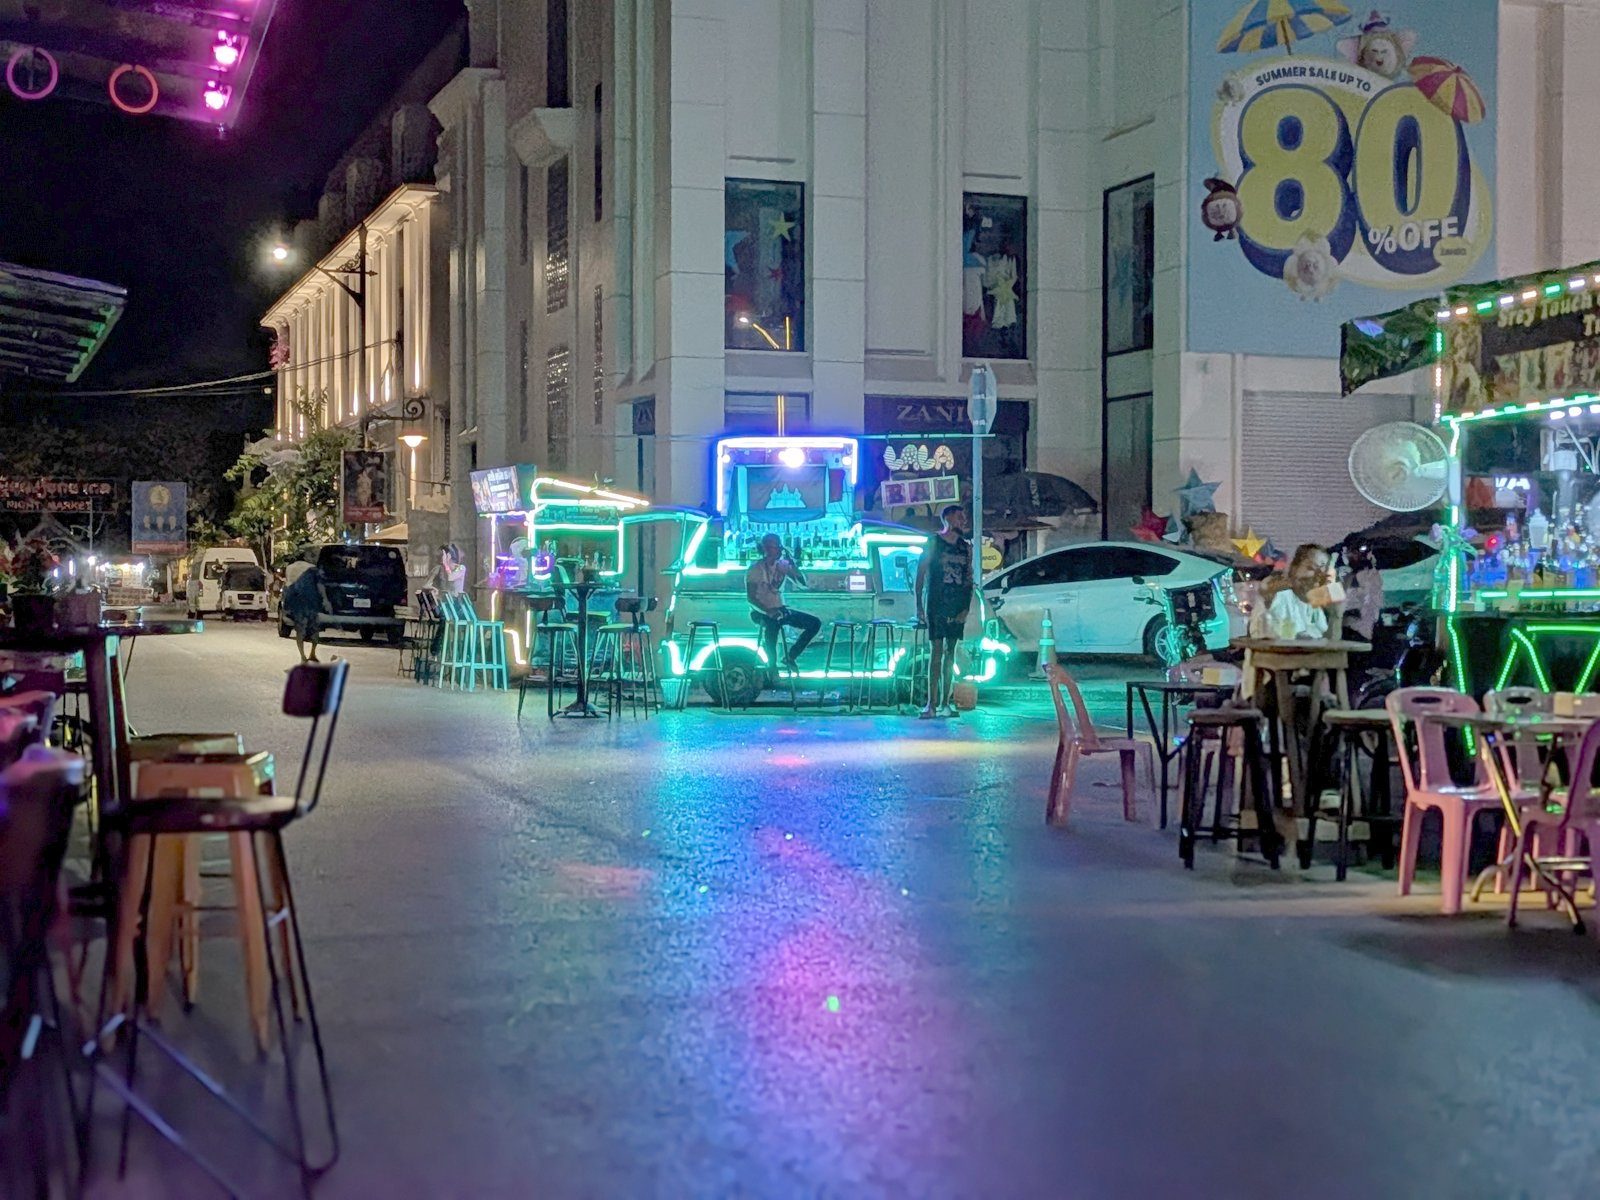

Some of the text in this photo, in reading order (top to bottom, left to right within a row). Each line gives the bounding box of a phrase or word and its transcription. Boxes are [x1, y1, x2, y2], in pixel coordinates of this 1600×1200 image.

[1255, 66, 1371, 92] SUMMER SALE UP TO
[1237, 83, 1468, 272] 80
